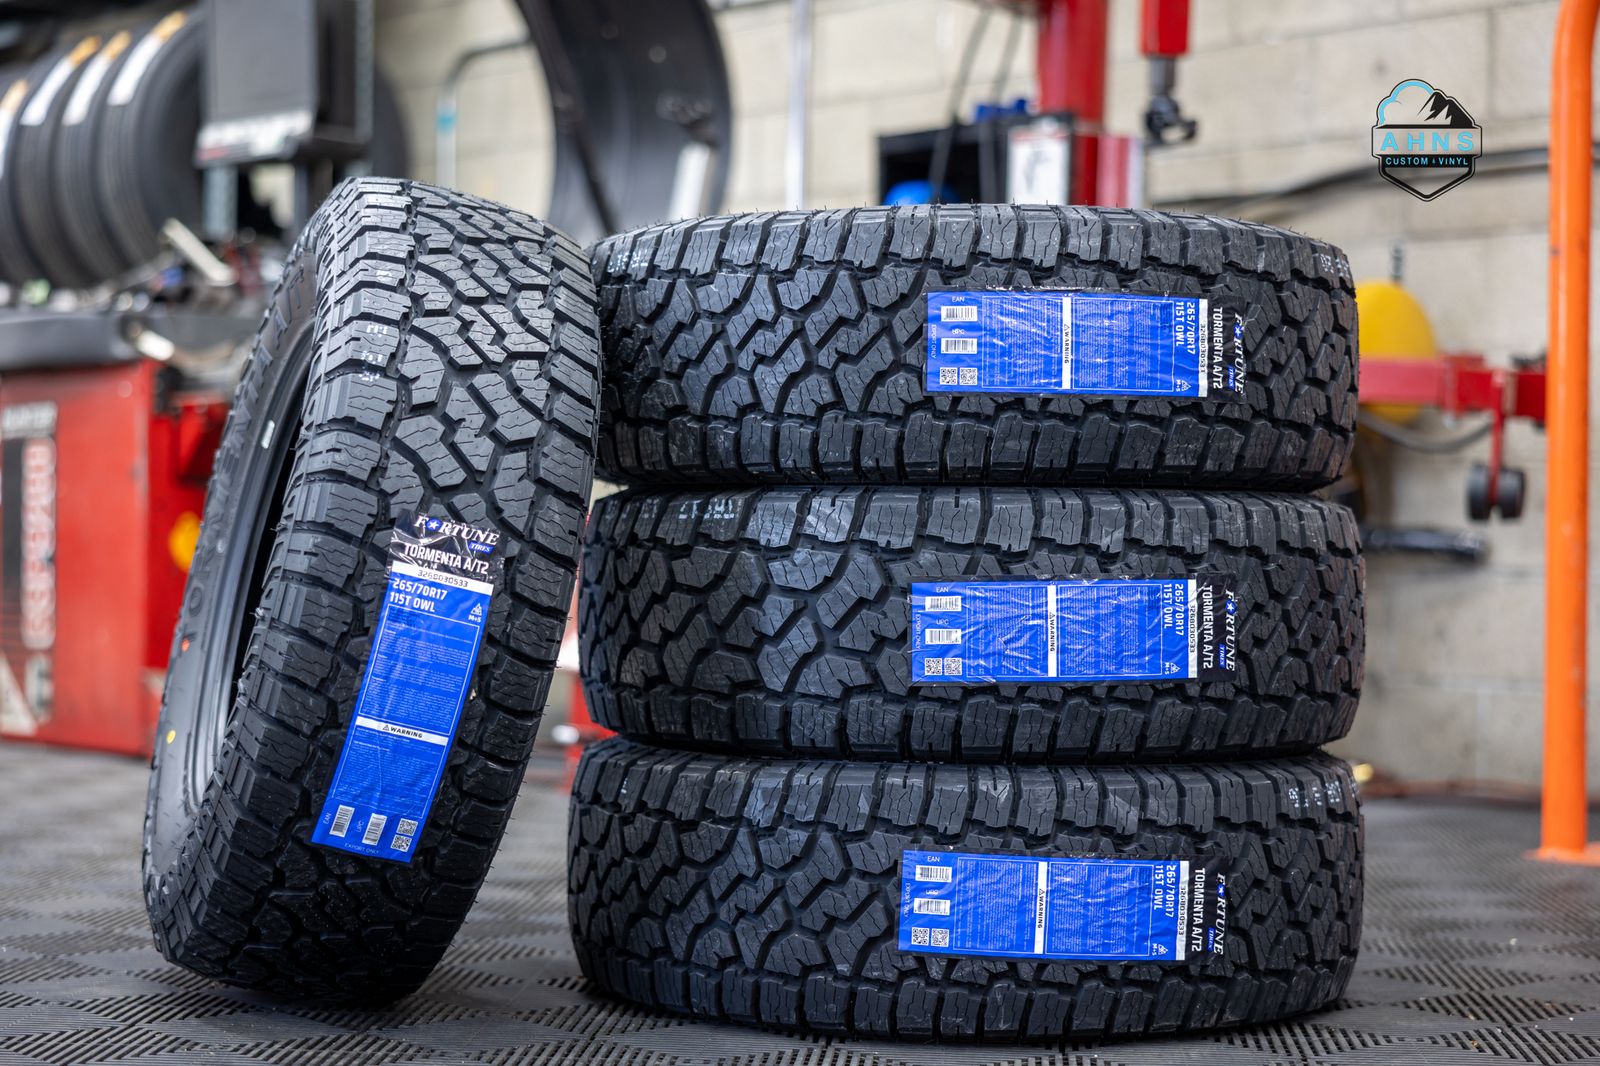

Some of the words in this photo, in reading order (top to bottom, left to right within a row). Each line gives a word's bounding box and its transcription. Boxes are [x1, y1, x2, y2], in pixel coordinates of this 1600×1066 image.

[1175, 301, 1185, 323] 115T
[1175, 325, 1185, 347] OWL
[1186, 301, 1196, 355] 265/70R17
[1213, 306, 1224, 363] TORMENTA
[1213, 364, 1224, 389] A/T2
[404, 542, 462, 569] TORMENTA
[463, 555, 490, 575] A/T2
[392, 577, 448, 601] 265/70R17
[1163, 583, 1173, 605] 115T
[389, 591, 411, 606] 115T
[412, 596, 436, 613] OWL
[1174, 583, 1184, 636] 265/70R17
[1202, 584, 1214, 643] TORMENTA
[1163, 607, 1173, 629] OWL
[1202, 644, 1214, 669] A/T2
[390, 726, 423, 739] WARNING
[1154, 864, 1164, 886] 115T
[1153, 888, 1164, 911] OWL
[1165, 864, 1177, 918] 265/70R17
[1192, 867, 1206, 925] TORMENTA
[1037, 895, 1045, 929] WARNING
[1191, 926, 1203, 952] A/T2
